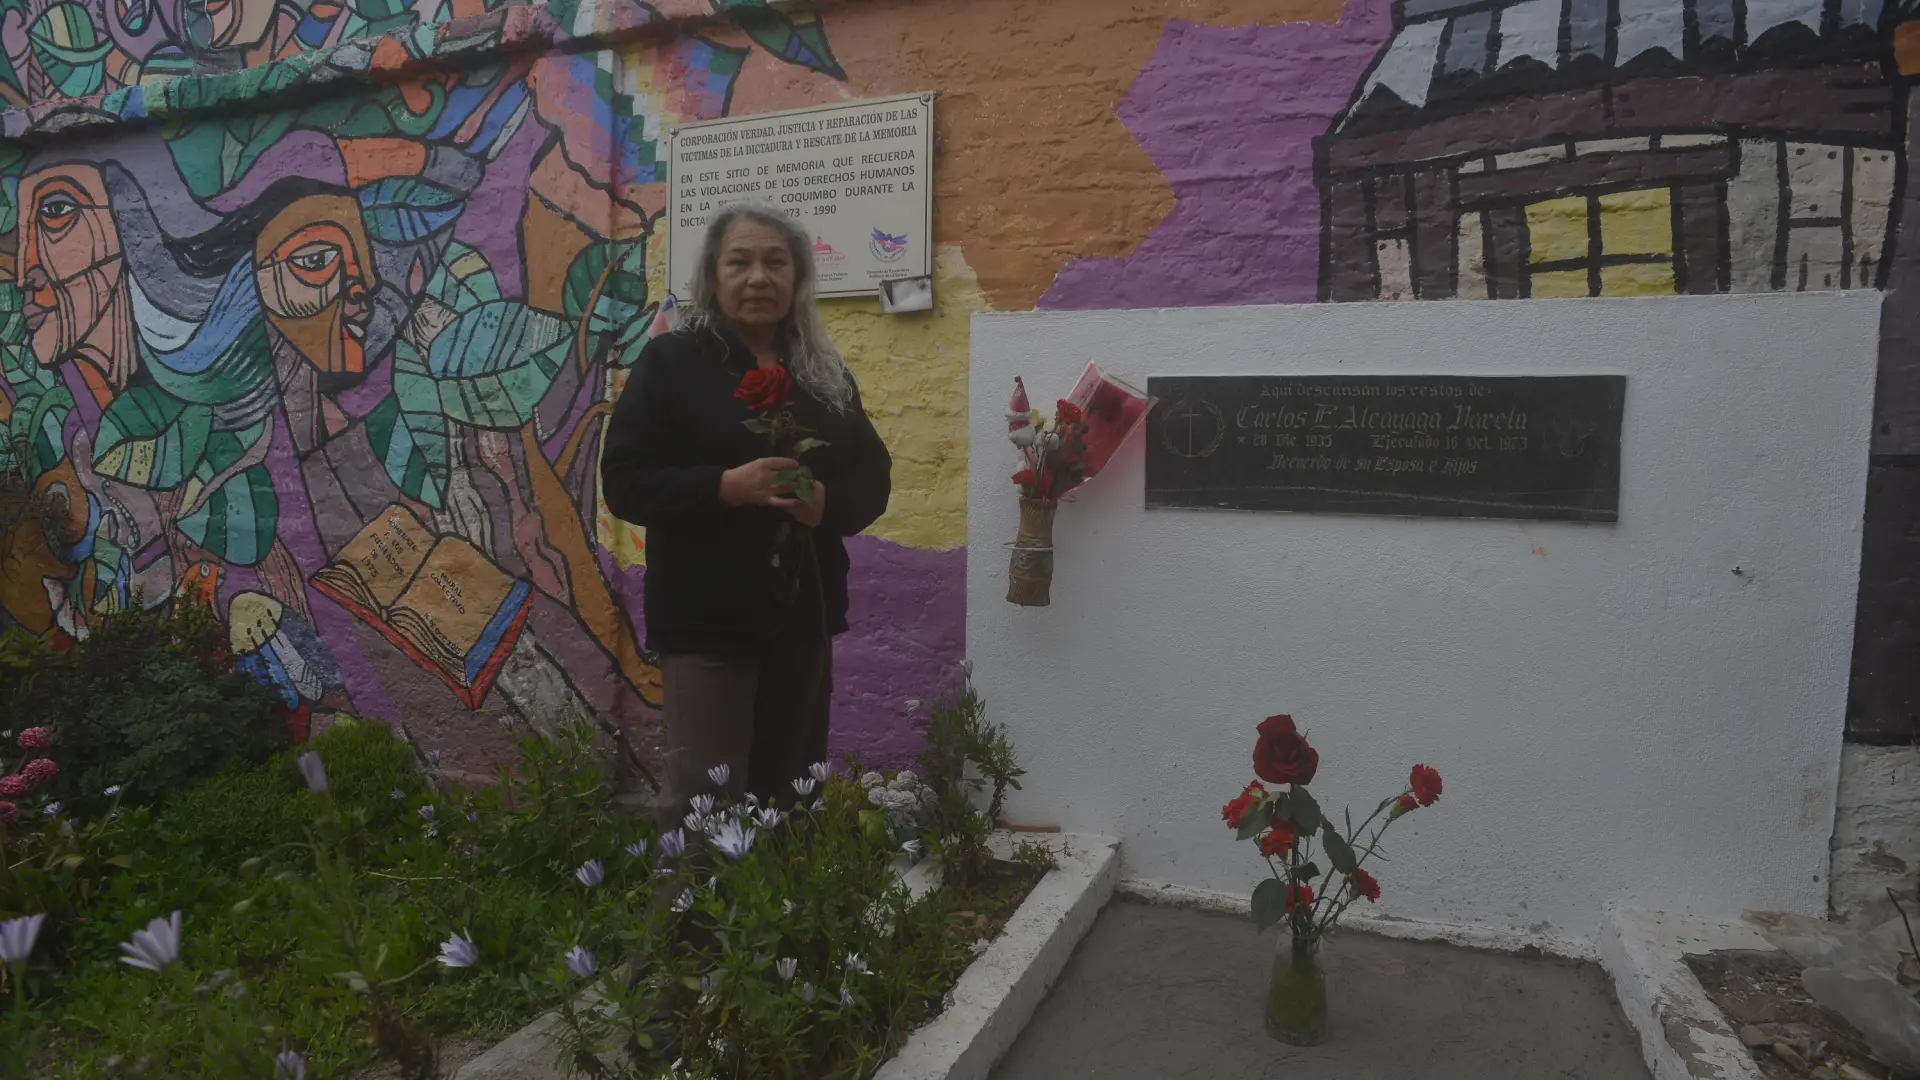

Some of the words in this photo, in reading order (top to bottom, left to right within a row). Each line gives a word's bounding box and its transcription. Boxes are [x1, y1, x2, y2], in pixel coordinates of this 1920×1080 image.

[680, 129, 738, 147] CORPORACIÓN
[777, 121, 816, 136] JUSTICIA
[818, 120, 824, 131] Y
[826, 110, 884, 130] REPARACIÓN
[886, 110, 898, 122] DE
[900, 108, 918, 121] LAS
[680, 147, 718, 163] VICTIMAS
[720, 147, 731, 158] DE
[733, 145, 744, 156] LA
[746, 139, 793, 155] DICTADURA
[793, 138, 801, 149] Y
[803, 135, 842, 149] RESCATE
[845, 132, 857, 144] DE
[859, 130, 870, 142] LA
[872, 125, 917, 141] MEMORIA
[681, 174, 693, 184] EN
[699, 171, 720, 182] ESTE
[726, 167, 750, 179] SITIO
[757, 165, 769, 176] DE
[776, 160, 825, 174] MEMORIA
[832, 156, 854, 168] QUE
[861, 149, 915, 165] RECUERDA
[680, 188, 696, 199] LAS
[701, 181, 761, 196] VIOLACIONES
[765, 180, 777, 190] DE
[782, 176, 800, 188] LOS
[804, 171, 855, 186] DERECHOS
[860, 165, 915, 180] HUMANOS
[680, 203, 692, 213] EN
[700, 201, 711, 212] LA
[781, 189, 837, 204] COQUIMBO
[845, 184, 893, 197] DURANTE
[902, 181, 915, 192] LA
[813, 204, 837, 216] 1990
[1385, 382, 1406, 397] los
[1409, 383, 1463, 397] restos
[1235, 403, 1308, 430] Carlos
[1446, 434, 1459, 449] 16
[440, 572, 463, 598] MURAL
